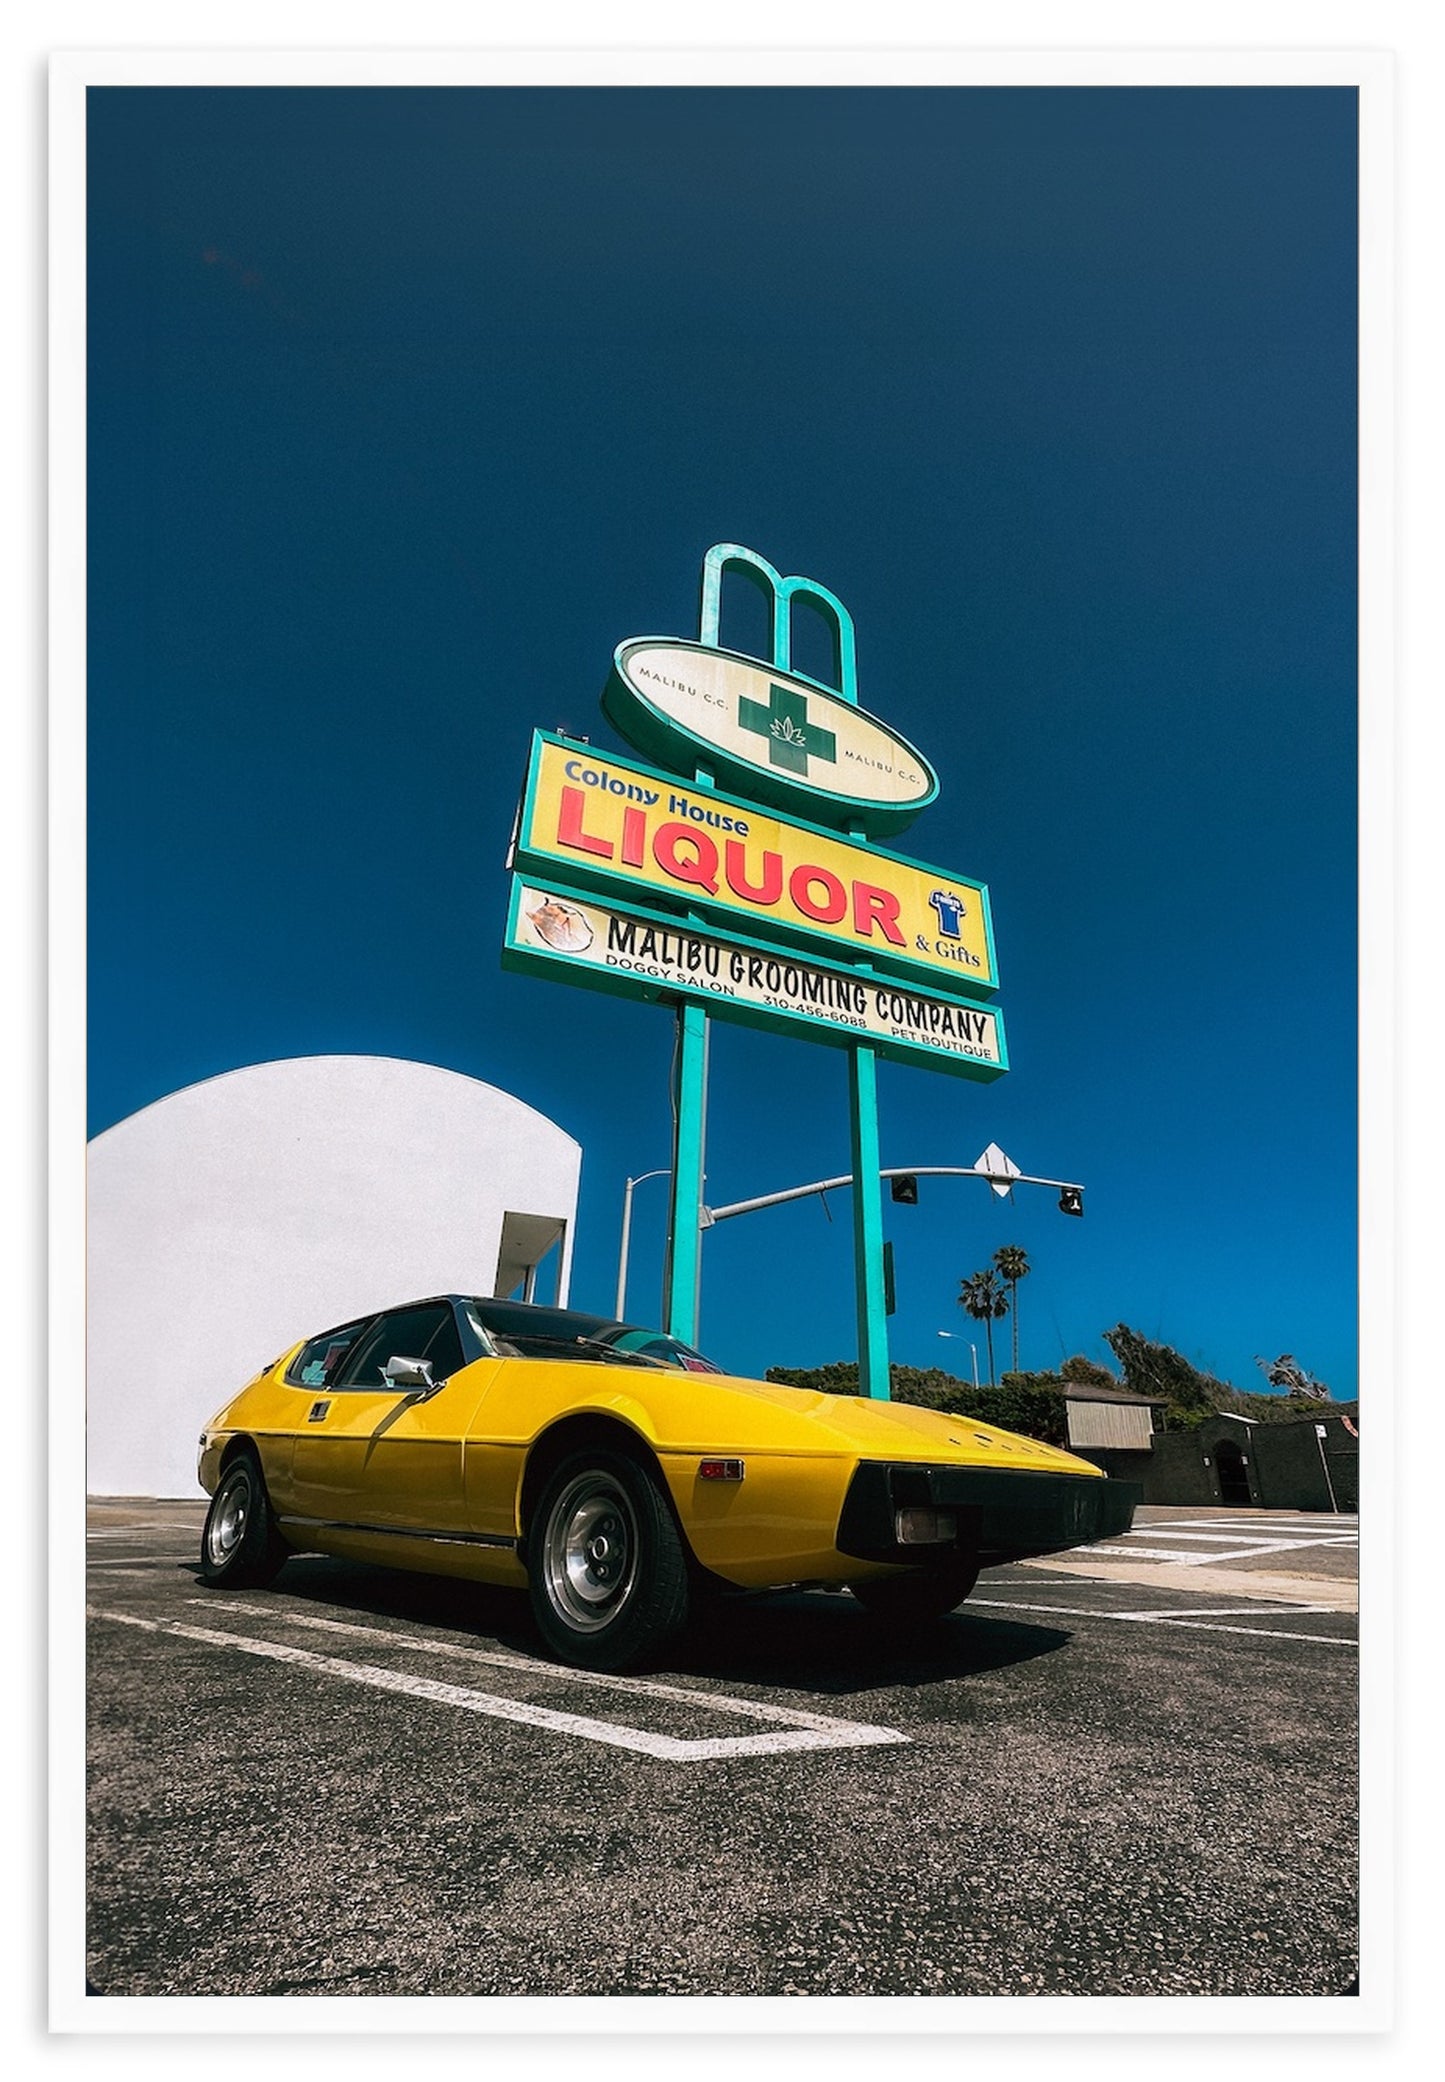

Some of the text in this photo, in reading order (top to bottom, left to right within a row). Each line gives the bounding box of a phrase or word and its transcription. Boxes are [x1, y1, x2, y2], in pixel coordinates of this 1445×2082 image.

[640, 667, 729, 710] MALIBU C.C.
[844, 750, 892, 773] MALIBU
[565, 760, 749, 836] Colony House
[557, 785, 907, 947] LIQUOR
[916, 934, 981, 967] & Gifts
[606, 954, 734, 996] DOGGY SALON
[608, 916, 986, 1043] MALIBU GROOMING COMPANY
[763, 994, 867, 1030] 310-456-6088
[891, 1026, 992, 1059] PET BOUTIQUE
